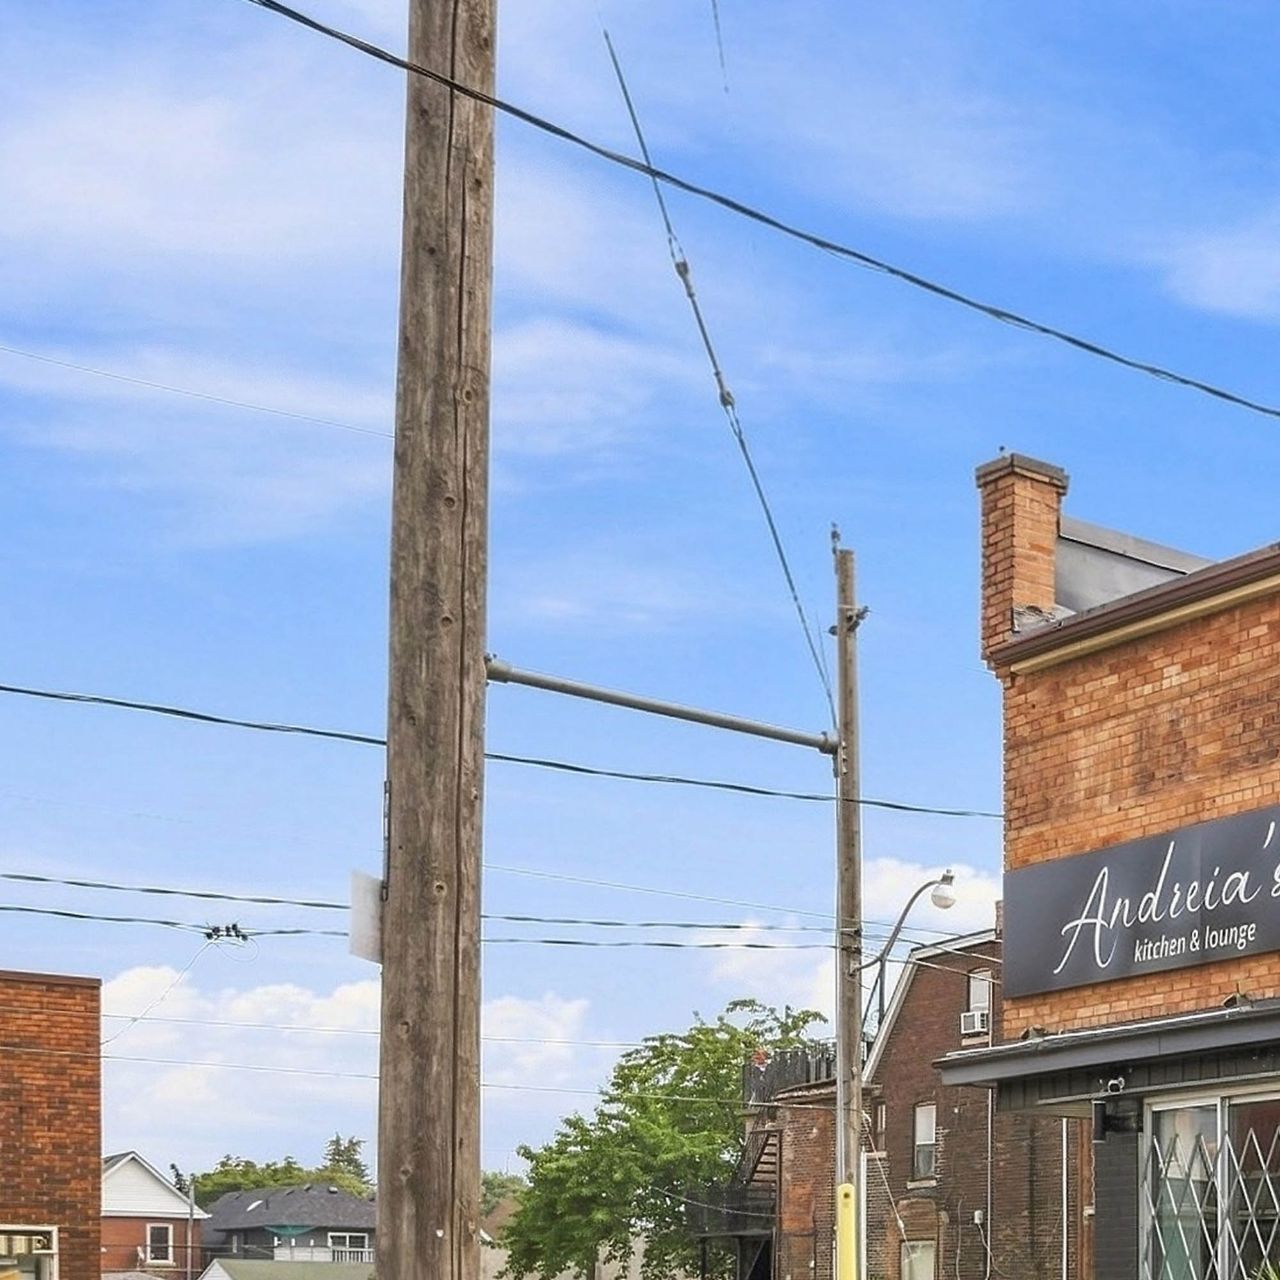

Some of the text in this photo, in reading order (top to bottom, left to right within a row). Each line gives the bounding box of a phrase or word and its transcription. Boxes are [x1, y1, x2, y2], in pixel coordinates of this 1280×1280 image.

[1134, 922, 1256, 962] kitchen & lounge
